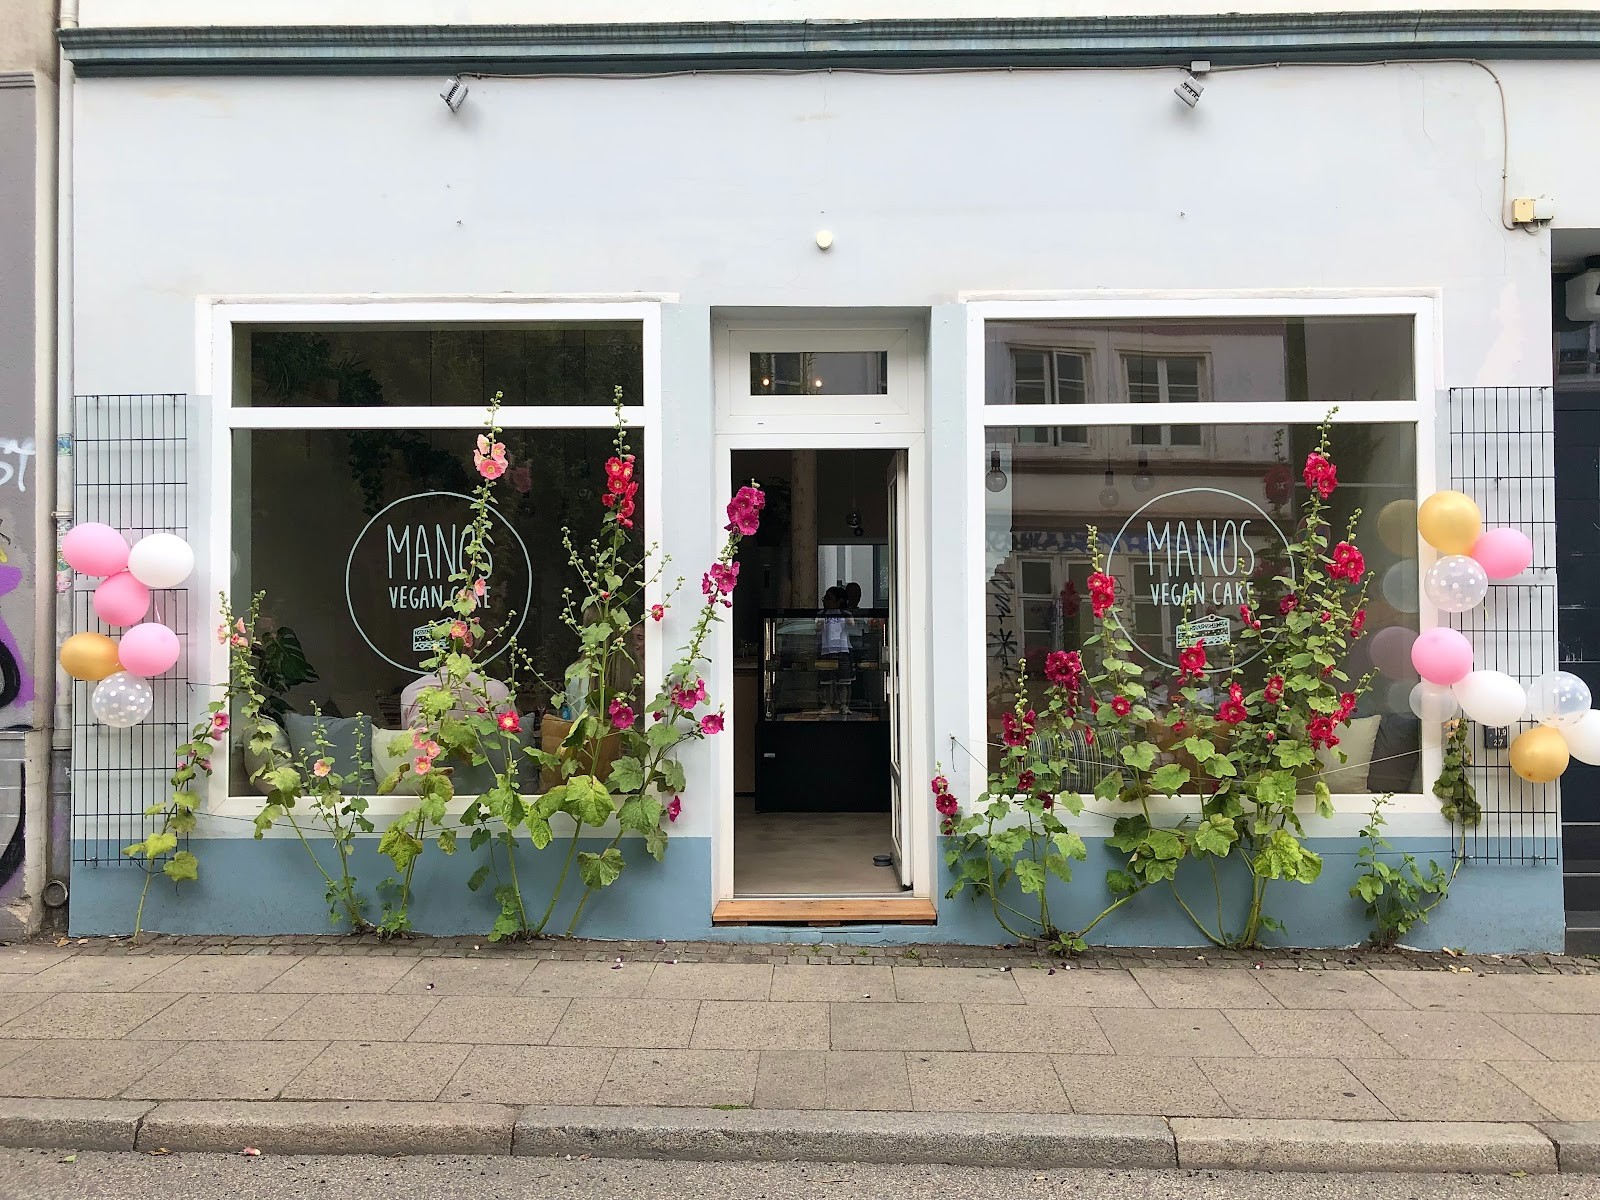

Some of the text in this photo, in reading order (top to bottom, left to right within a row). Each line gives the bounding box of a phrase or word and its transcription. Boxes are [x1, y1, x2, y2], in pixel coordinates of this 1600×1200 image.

[1147, 519, 1255, 577] MANOS
[388, 584, 492, 609] VEGAN CE
[1150, 581, 1205, 606] VEGAN
